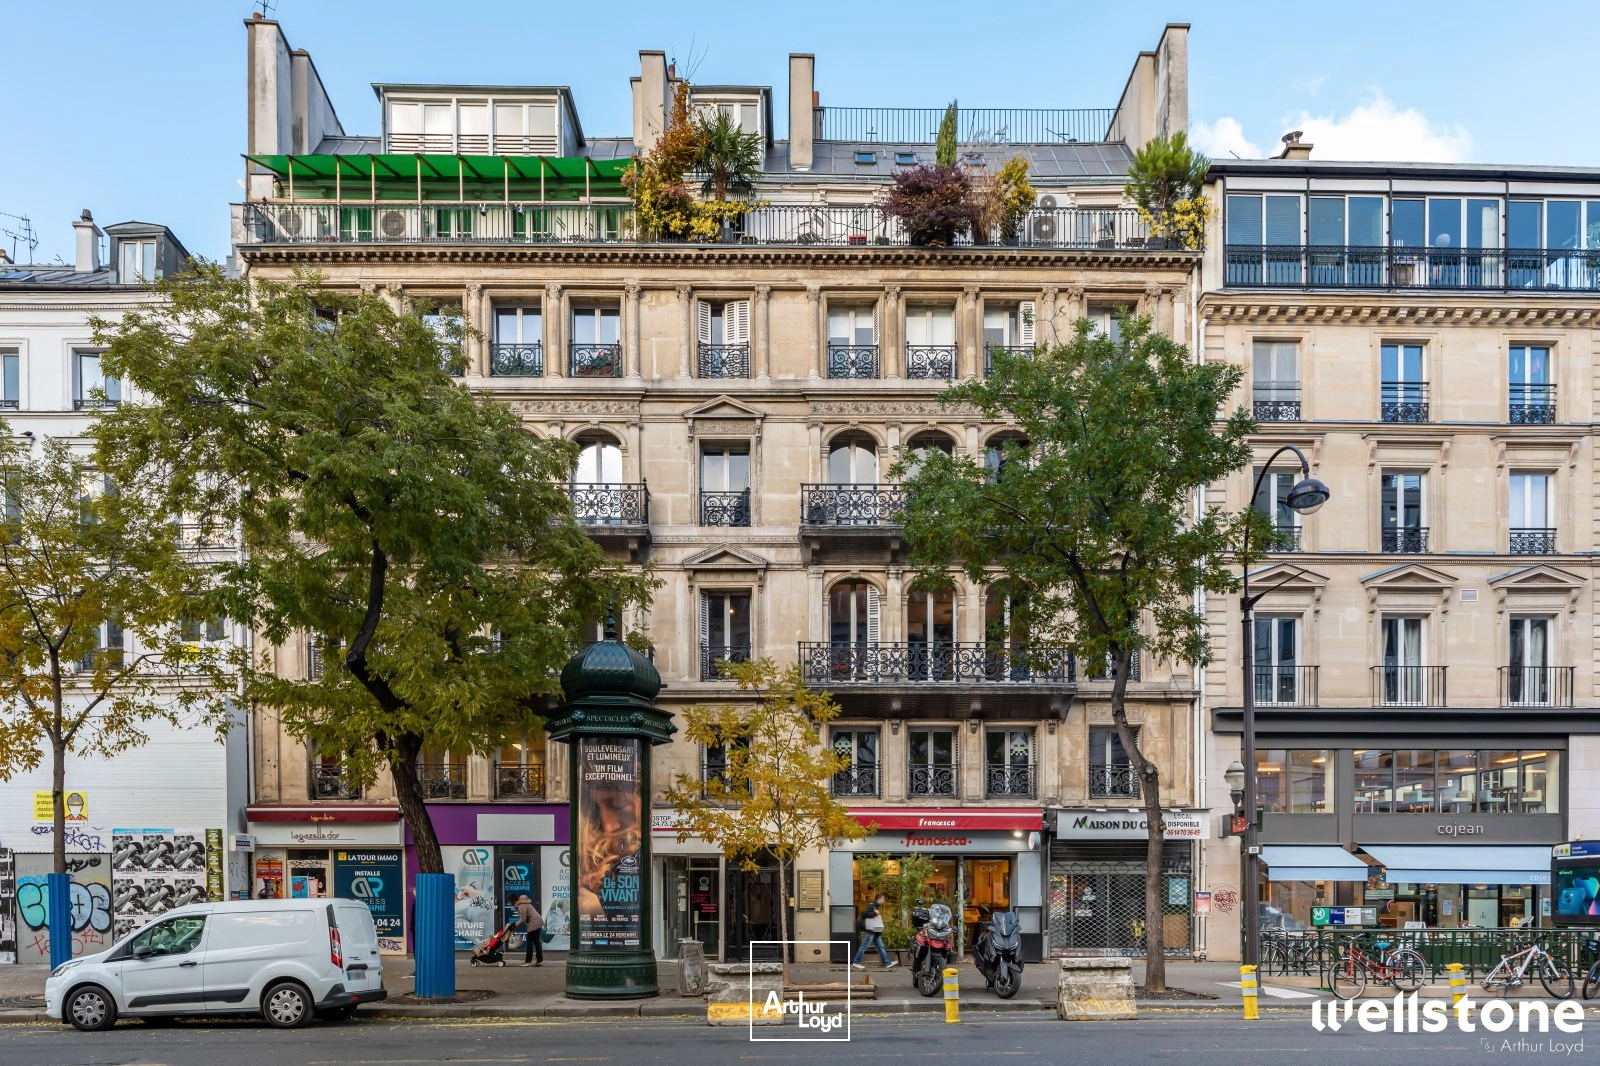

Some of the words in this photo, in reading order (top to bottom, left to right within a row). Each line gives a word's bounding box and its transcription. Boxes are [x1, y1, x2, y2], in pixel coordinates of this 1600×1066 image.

[586, 714, 629, 722] SPECTACLES
[607, 765, 623, 773] FILM
[585, 773, 633, 782] EXCEPTIONNEL
[1073, 816, 1120, 829] MAISON
[1122, 821, 1137, 829] DU
[1437, 822, 1484, 838] cojean
[905, 832, 967, 847] francesca
[604, 877, 615, 889] De
[618, 875, 639, 889] SON
[601, 889, 639, 902] VIVANT
